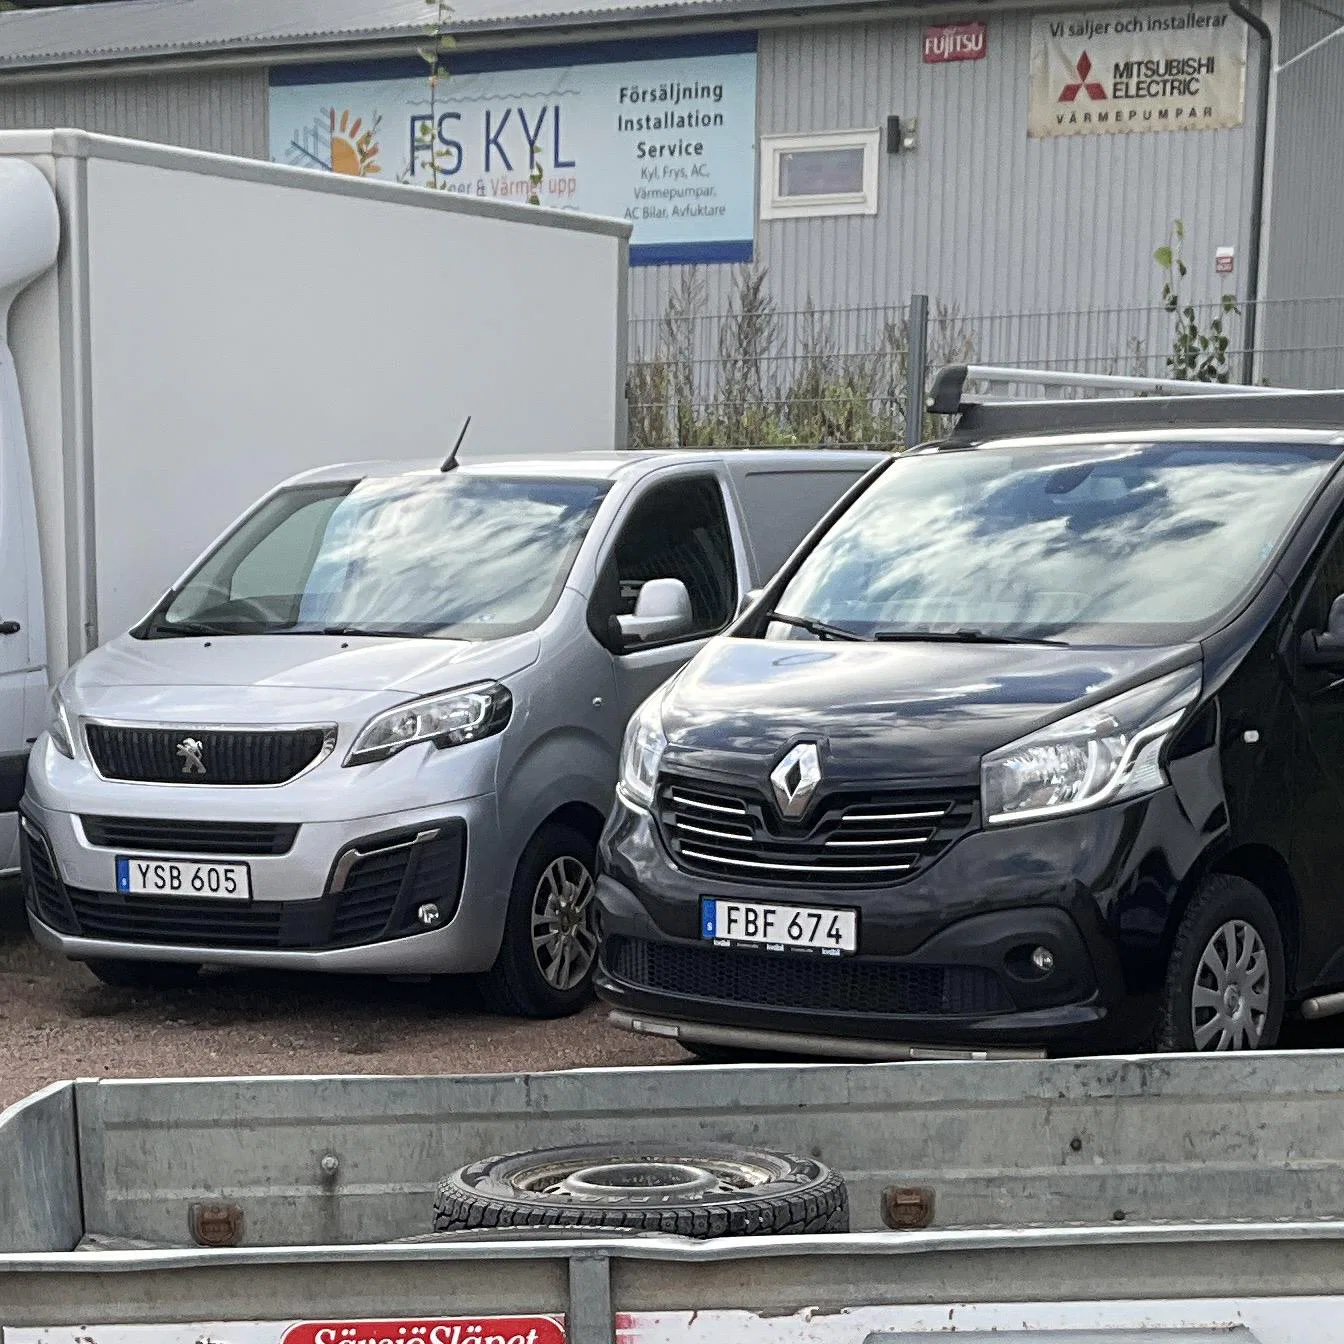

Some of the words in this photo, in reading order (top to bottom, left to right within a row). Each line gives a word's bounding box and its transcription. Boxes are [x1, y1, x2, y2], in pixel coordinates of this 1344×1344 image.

[1050, 22, 1064, 38] Vi
[1114, 15, 1143, 33] och
[1147, 13, 1228, 31] installerar
[925, 29, 983, 58] FUJITSU
[1113, 56, 1215, 79] MITSUBISHI
[619, 82, 723, 104] Försäljning
[1112, 77, 1200, 99] ELECTRIC
[618, 110, 723, 131] Installation
[410, 112, 463, 176] FS
[485, 105, 576, 172] KYL
[637, 139, 703, 158] Service
[548, 177, 577, 197] upp
[624, 207, 639, 219] AC
[672, 203, 726, 216] Avfuktare
[138, 864, 182, 890] YSB
[191, 866, 237, 893] 605
[727, 906, 776, 938] FBF
[787, 911, 842, 944] 674
